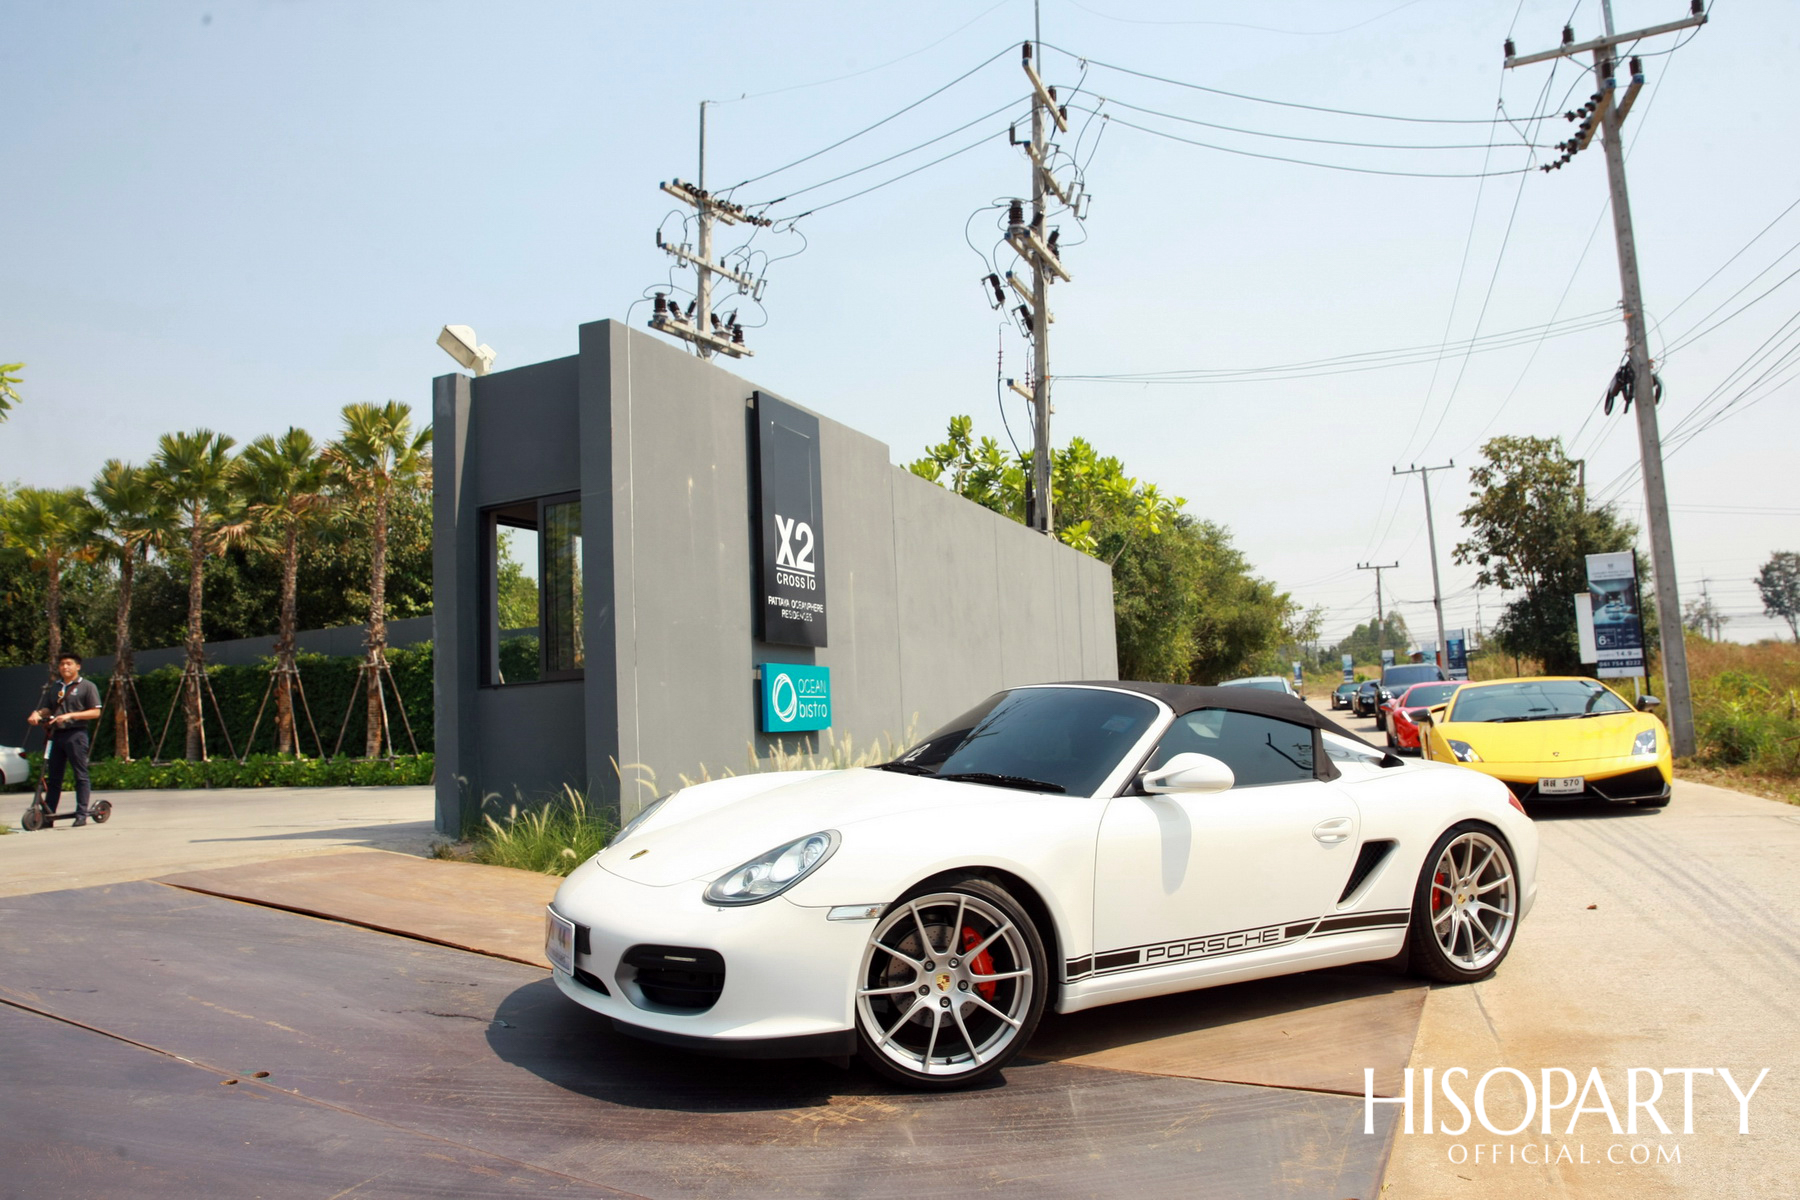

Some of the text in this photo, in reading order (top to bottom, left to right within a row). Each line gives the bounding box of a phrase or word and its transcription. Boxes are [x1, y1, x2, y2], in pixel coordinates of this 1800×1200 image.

[774, 514, 815, 572] X2
[798, 679, 826, 693] OCEAN
[799, 701, 828, 718] bistro
[1563, 779, 1580, 787] 570
[1146, 928, 1279, 962] PORSCHE
